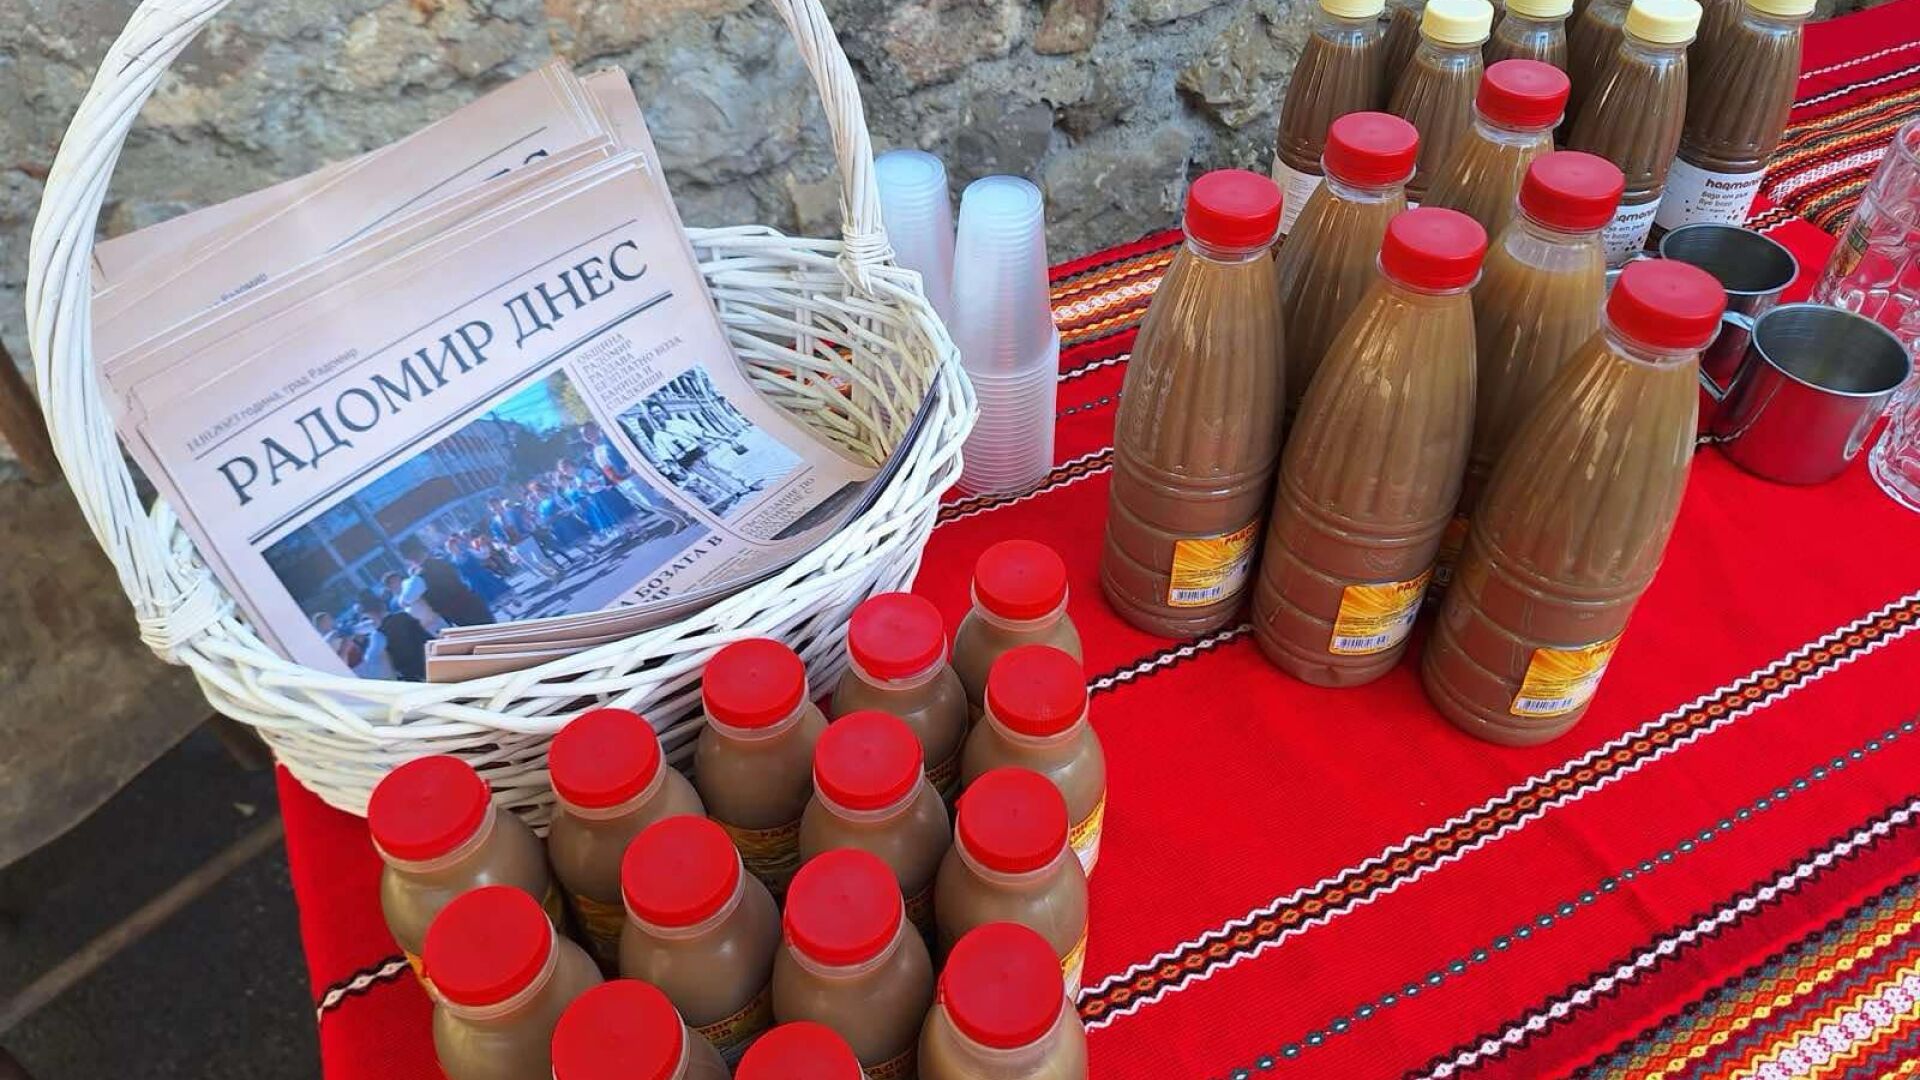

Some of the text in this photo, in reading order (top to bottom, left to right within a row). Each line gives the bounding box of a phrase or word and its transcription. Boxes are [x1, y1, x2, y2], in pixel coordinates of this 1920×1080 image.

[217, 240, 648, 506] РАДОМИР ДНЕС
[634, 548, 708, 599] БОЗАТА
[707, 534, 723, 547] В
